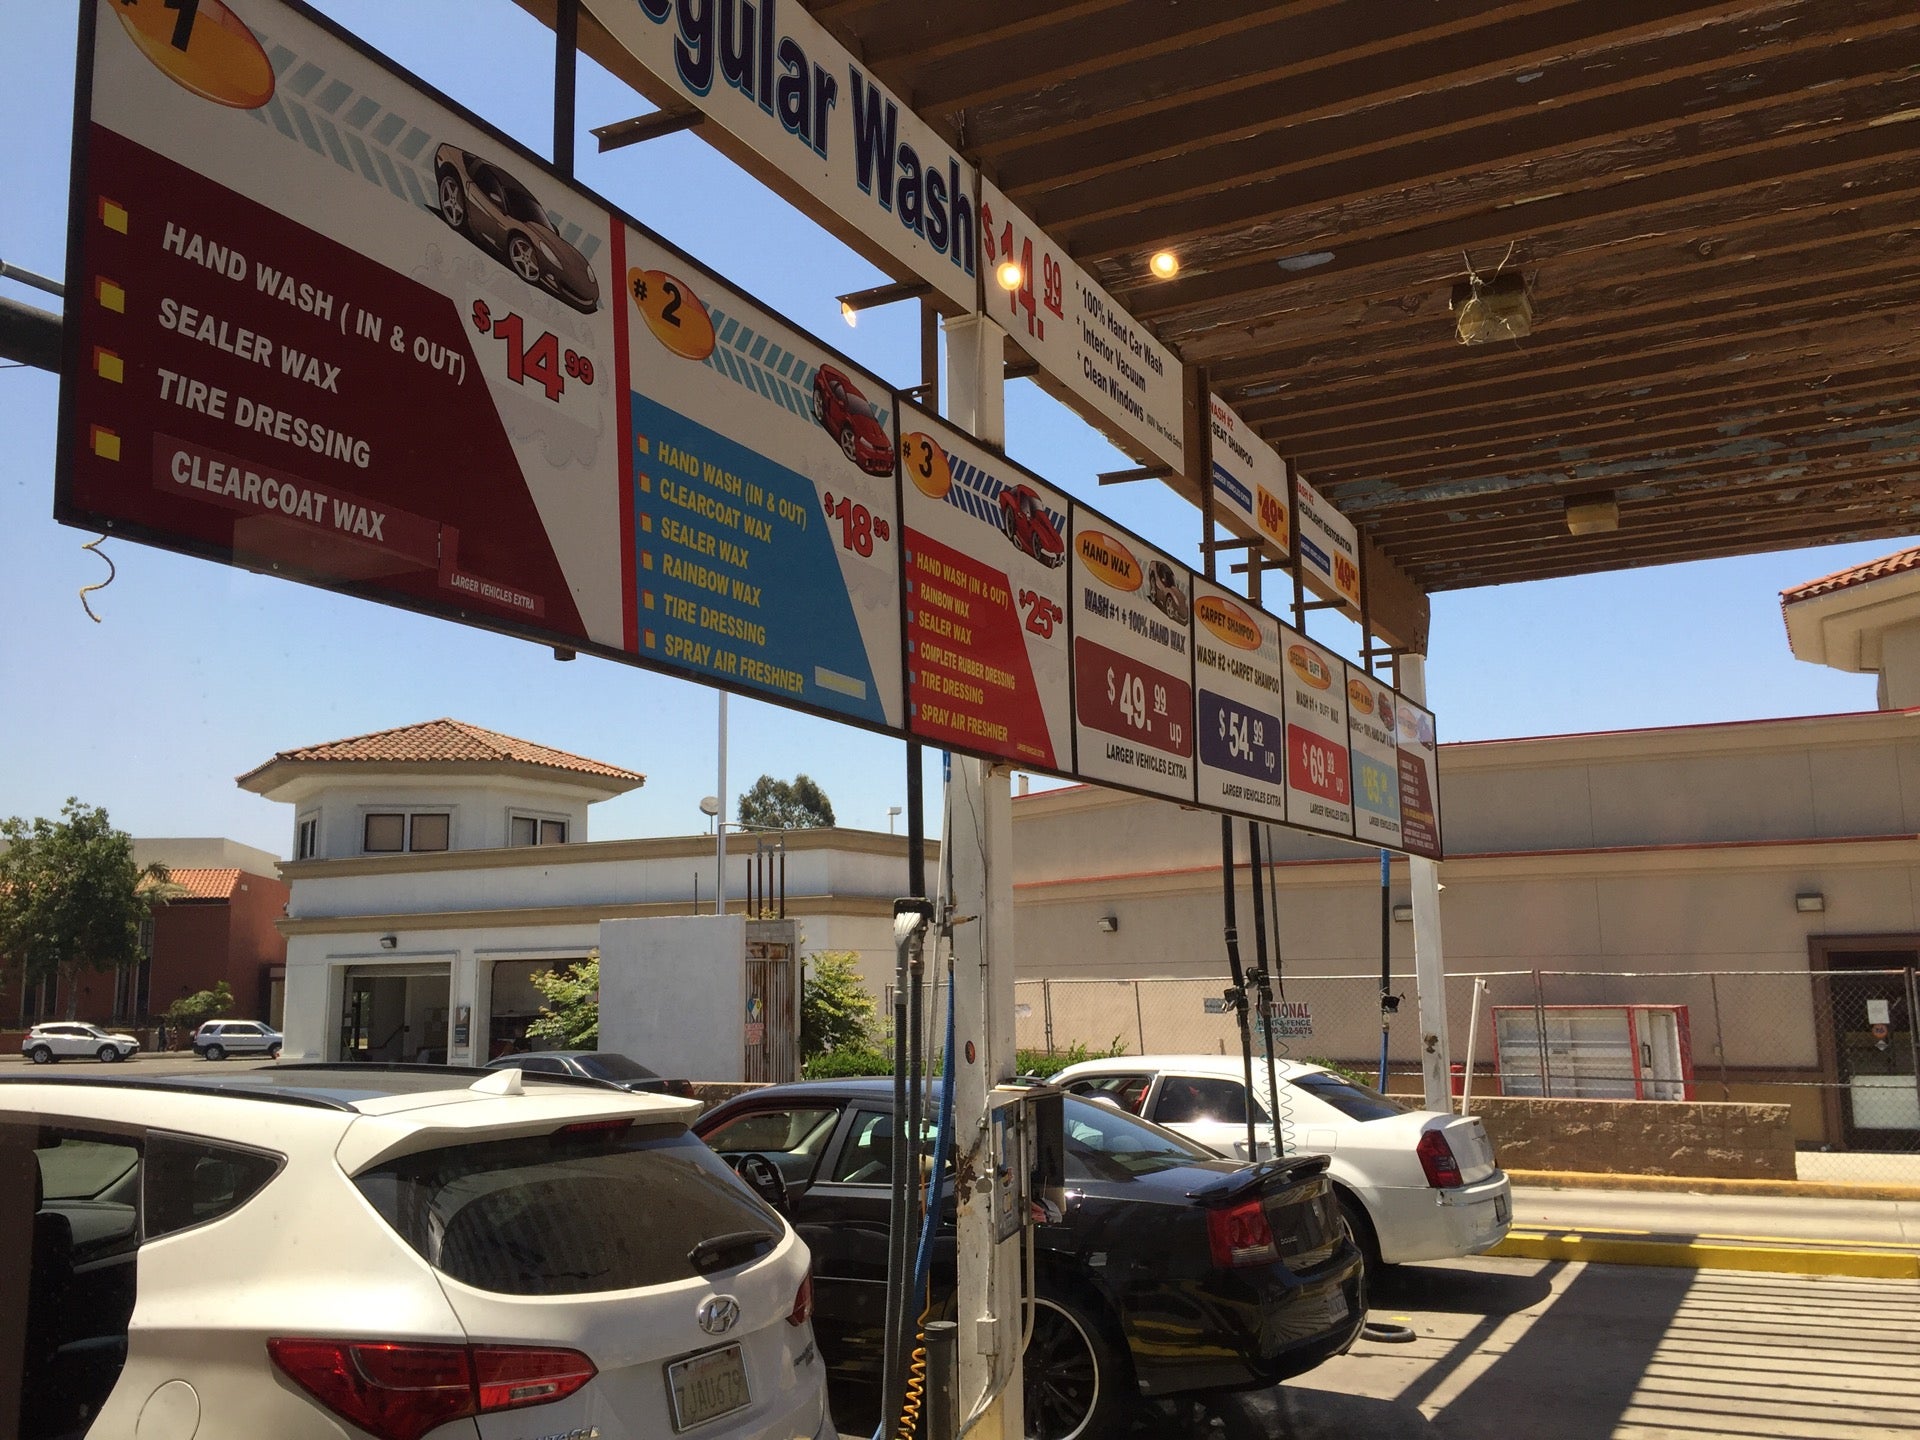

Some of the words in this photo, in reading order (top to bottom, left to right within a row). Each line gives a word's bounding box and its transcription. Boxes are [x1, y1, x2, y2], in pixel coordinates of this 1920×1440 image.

[637, 0, 838, 160] gular
[849, 62, 976, 280] Wash
[162, 222, 247, 283] HAND
[256, 265, 334, 322] WASH
[390, 326, 406, 353] &
[413, 336, 466, 385] OUT)
[158, 298, 272, 369] SEALER
[281, 345, 341, 394] WAX
[1083, 286, 1106, 326] 100%
[1107, 310, 1127, 345] Hand
[1129, 331, 1143, 356] Car
[1144, 342, 1163, 377] Wash
[1083, 320, 1114, 366] Interior
[1115, 350, 1146, 393] Vacuum
[1084, 356, 1107, 394] Clean
[1109, 379, 1144, 422] Windows
[157, 368, 226, 419] TIRE
[235, 389, 371, 469] DRESSING
[1228, 436, 1253, 469] SHAMPOO
[171, 451, 326, 524] CLEARCOAT
[333, 498, 386, 542] WAX
[659, 441, 699, 477] HAND
[703, 461, 741, 497] WASH
[745, 482, 763, 507] (IN
[767, 492, 775, 512] &
[779, 499, 807, 532] OUT)
[660, 478, 740, 530] CLEARCOAT
[744, 513, 772, 544] WAX
[661, 517, 715, 557] SEALER
[719, 540, 749, 570] WAX
[1082, 539, 1109, 569] HAND
[1111, 555, 1132, 579] WAX
[451, 573, 478, 593] LARGER
[480, 582, 512, 603] VEHICLES
[513, 593, 535, 611] EXTRA
[662, 553, 729, 595] RAINBOW
[732, 578, 762, 608] WAX
[917, 552, 941, 577] HAND
[943, 564, 967, 589] WASH
[969, 575, 980, 595] (IN
[982, 583, 988, 598] &
[990, 586, 1009, 611] OUT)
[921, 583, 954, 612] RAINBOW
[954, 597, 970, 619] WAX
[664, 593, 696, 624] TIRE
[701, 607, 766, 646] DRESSING
[919, 610, 951, 638] SEALER
[954, 623, 972, 646] WAX
[1084, 587, 1109, 619] WASH
[1128, 608, 1148, 638] 100%
[1149, 618, 1169, 647] HAND
[1170, 629, 1186, 656] WAX
[1200, 604, 1226, 628] CARPET
[1227, 617, 1255, 642] SHAMPOO
[665, 634, 710, 666] SPRAY
[713, 648, 736, 674] AIR
[740, 658, 804, 694] FRESHNER
[921, 642, 956, 670] COMPLETE
[958, 656, 984, 679] RUBBER
[985, 666, 1015, 691] DRESSING
[921, 671, 940, 692] TIRE
[943, 679, 984, 705] DRESSING
[1197, 644, 1217, 669] WASH
[1254, 671, 1280, 695] SHAMPOO
[922, 703, 949, 726] SPRAY
[951, 714, 965, 731] AIR
[967, 719, 1008, 743] FRESHNER
[1170, 720, 1182, 749] up
[1106, 742, 1134, 766] LARGER
[1135, 751, 1167, 775] VEHICLES
[1168, 760, 1187, 780] EXTRA
[1265, 750, 1275, 774] up
[1222, 782, 1243, 800] LARGER
[1243, 787, 1266, 805] VEHICLES
[1267, 793, 1282, 808] EXTRA
[1256, 1002, 1310, 1018] TIONAL
